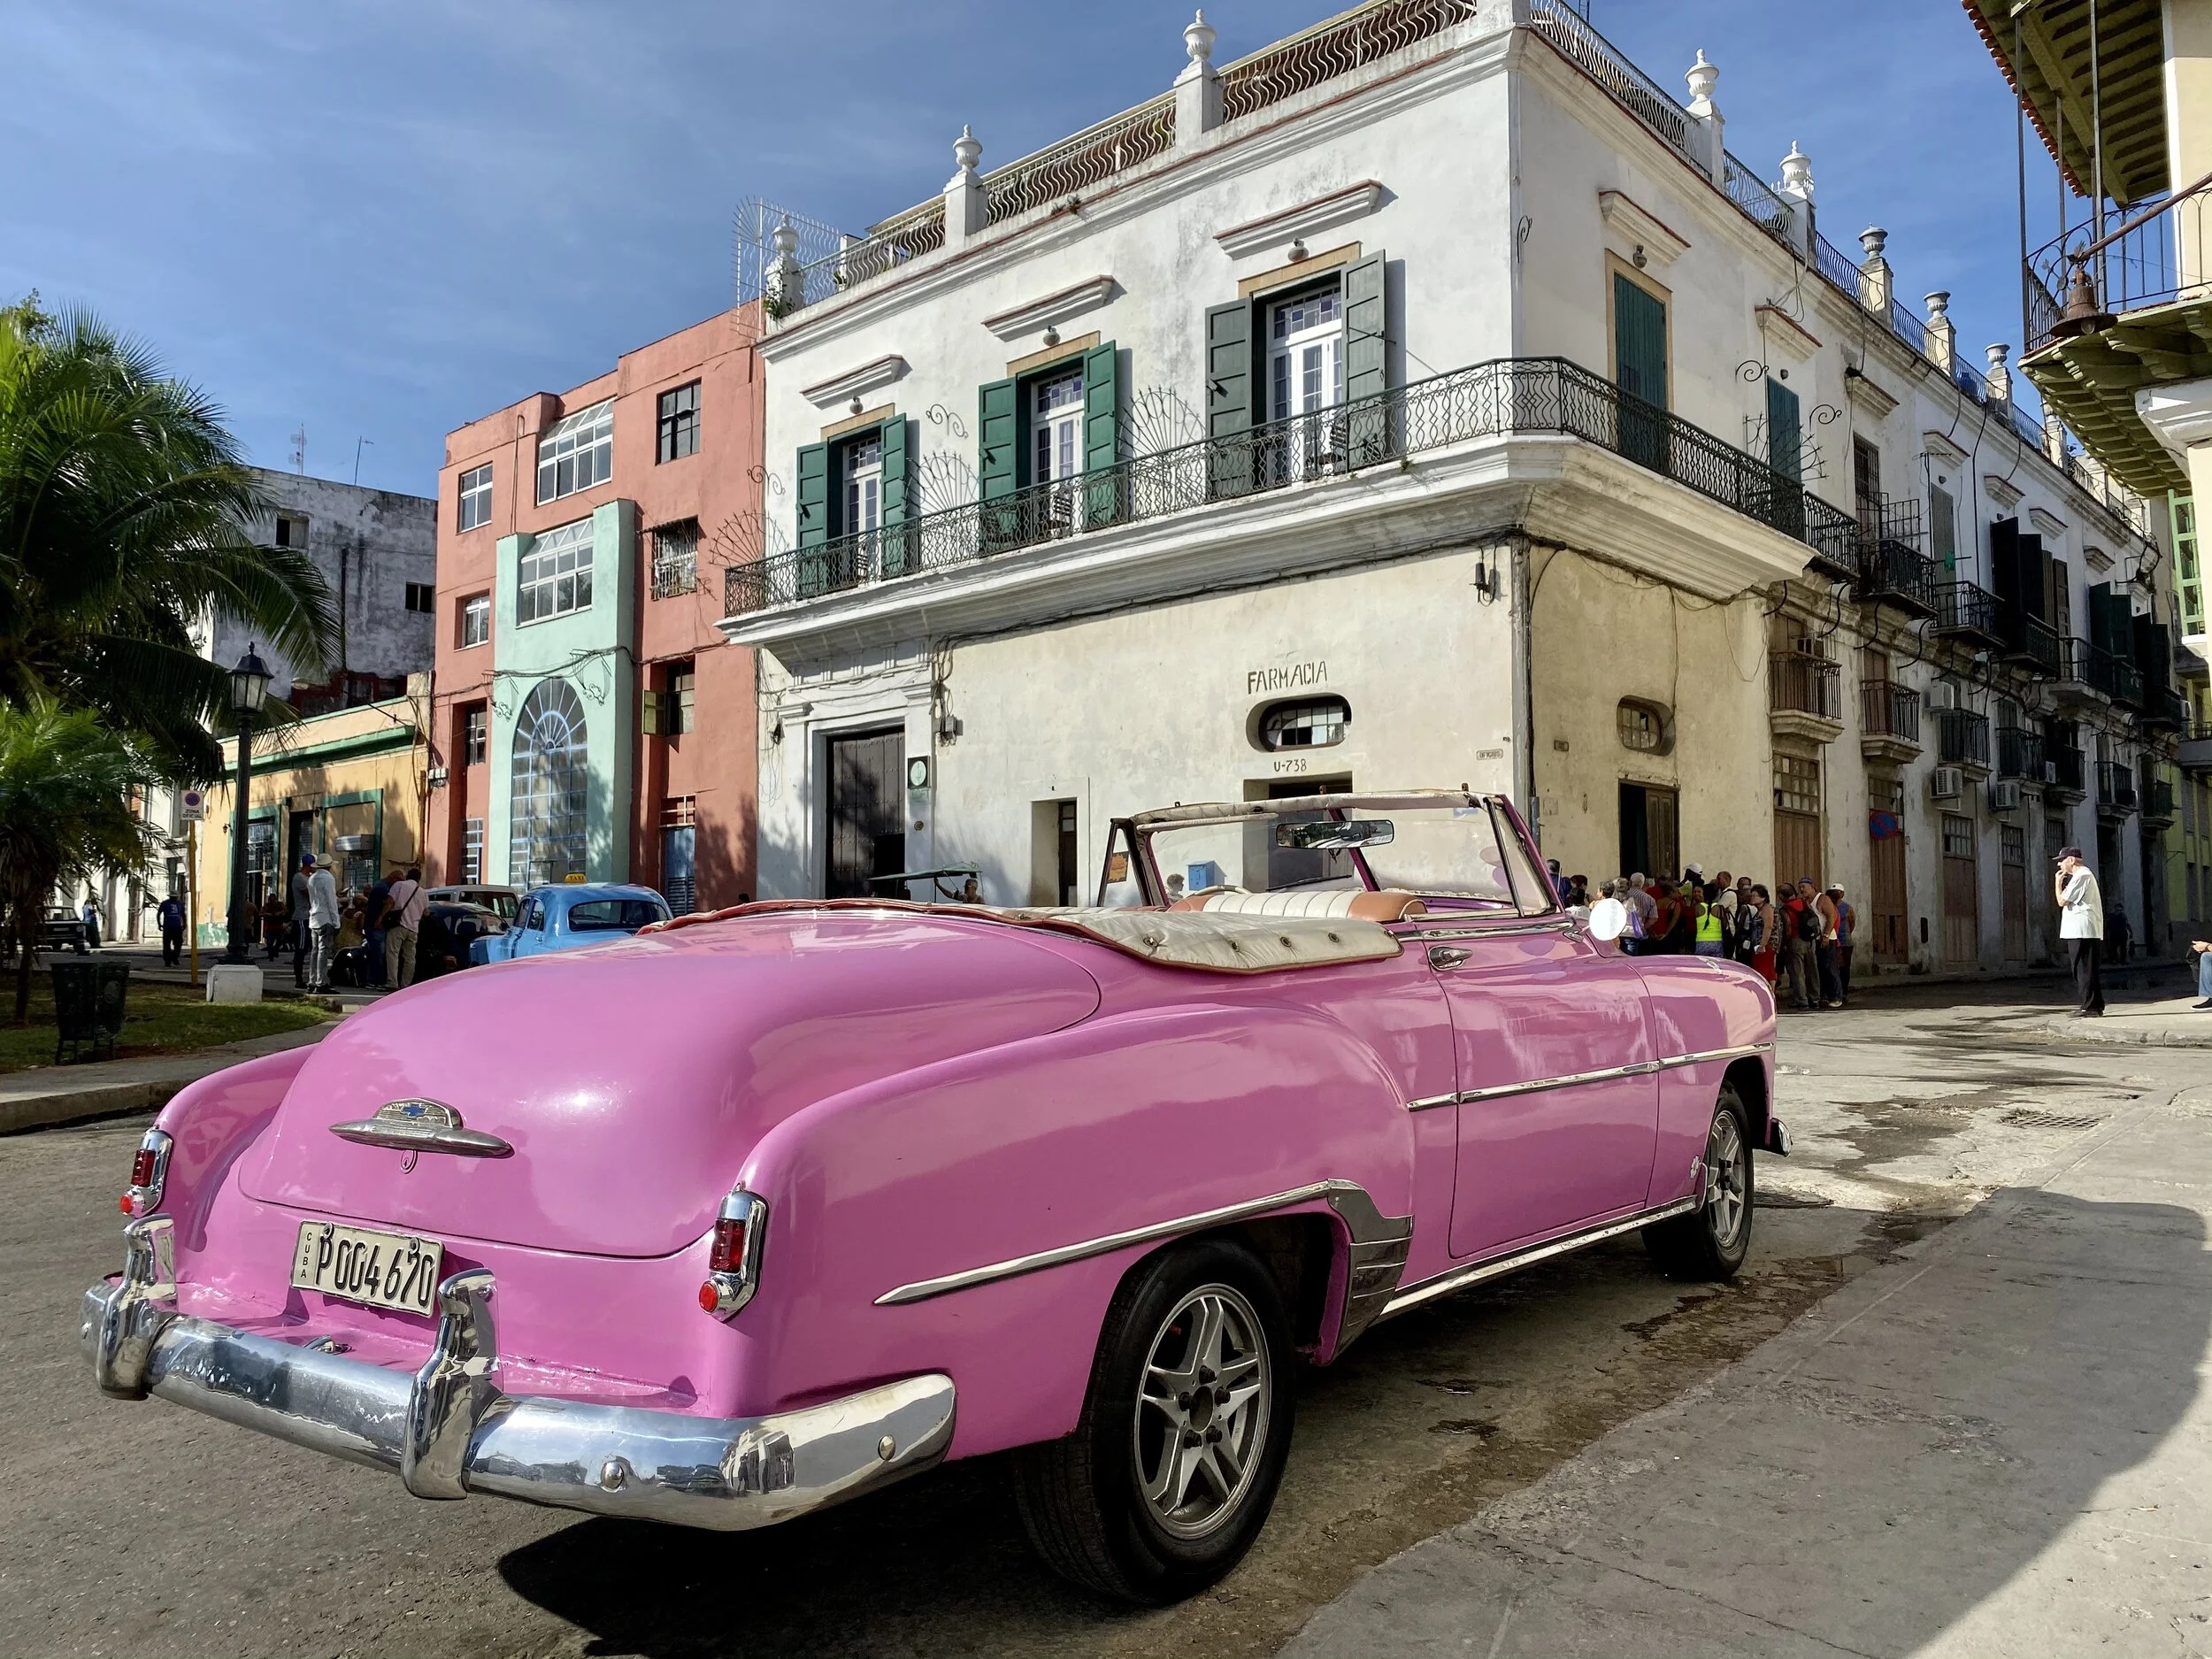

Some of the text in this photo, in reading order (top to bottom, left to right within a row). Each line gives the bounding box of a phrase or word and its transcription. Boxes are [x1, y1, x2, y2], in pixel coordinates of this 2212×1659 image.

[1248, 661, 1327, 695] FARMACIA
[1273, 758, 1308, 772] U-738
[300, 1232, 312, 1279] CUBA
